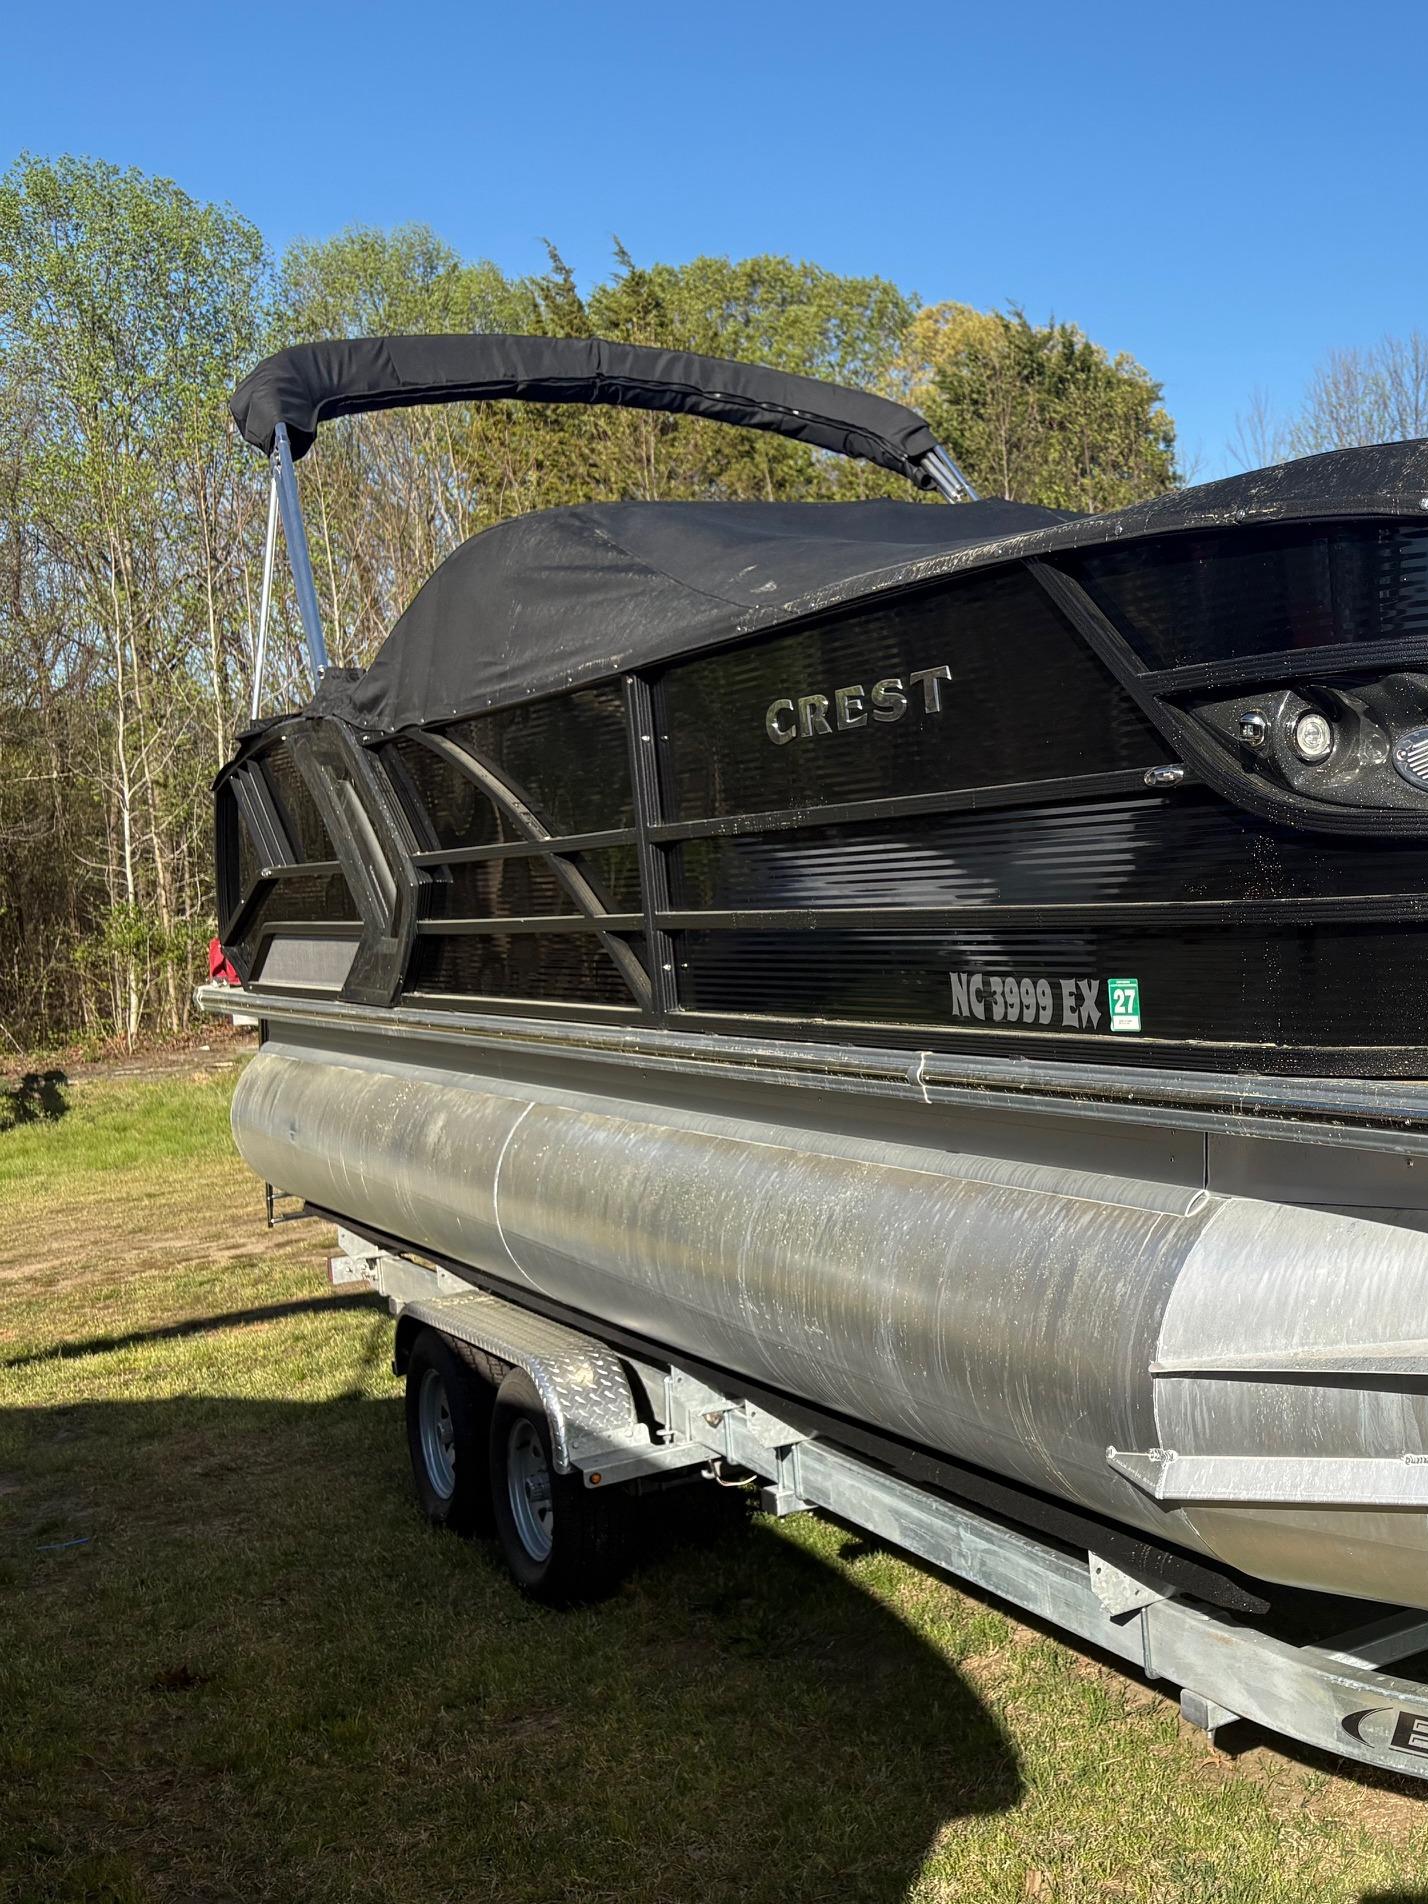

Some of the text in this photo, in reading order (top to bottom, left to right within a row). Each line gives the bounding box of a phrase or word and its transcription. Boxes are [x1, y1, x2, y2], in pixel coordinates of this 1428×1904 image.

[766, 665, 952, 745] CREST
[949, 972, 1101, 1030] NC 3999 EX
[1113, 988, 1136, 1013] 27
